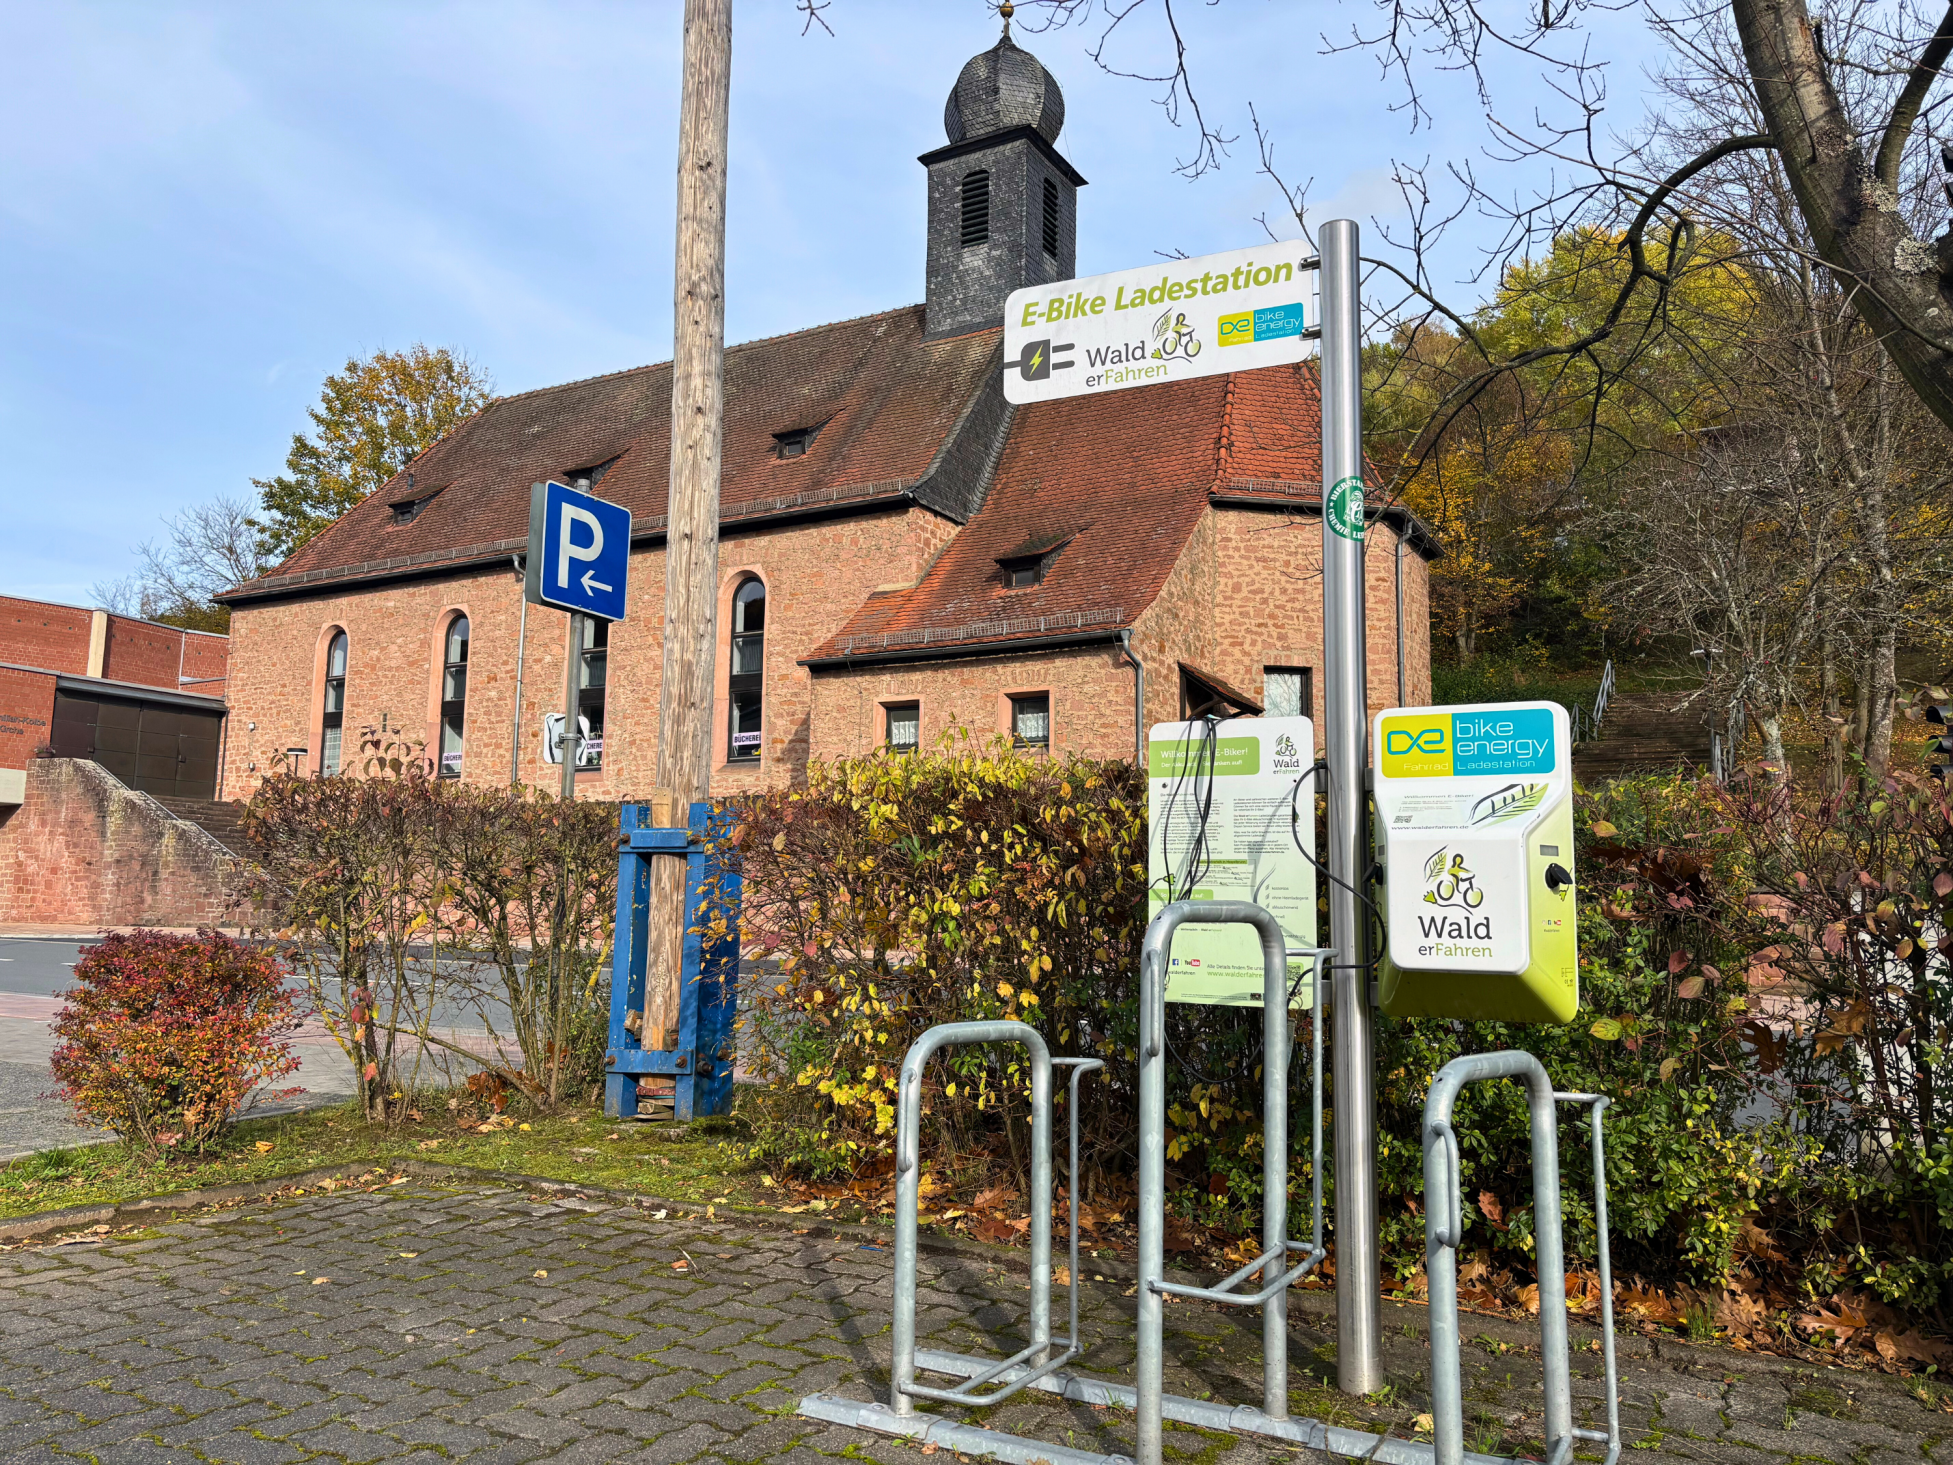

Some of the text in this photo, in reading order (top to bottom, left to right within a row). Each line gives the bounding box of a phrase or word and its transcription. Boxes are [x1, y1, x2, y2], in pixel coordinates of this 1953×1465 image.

[1020, 262, 1293, 327] E-Bike Ladestation
[1256, 311, 1284, 322] bike
[1256, 318, 1302, 332] energy
[1256, 328, 1294, 338] Ladestation
[1086, 340, 1146, 368] Wald
[1086, 364, 1168, 387] erFahren
[1330, 479, 1364, 500] BIERSTA
[1328, 508, 1350, 536] CHEMIE
[558, 502, 604, 589] P
[1456, 719, 1514, 738] bike
[1216, 748, 1248, 756] E-Biker!
[1456, 738, 1549, 758] energy
[1273, 758, 1300, 768] Wald
[1404, 760, 1536, 771] Fahrrad Ladestation
[1418, 916, 1492, 940] Wald
[1418, 943, 1492, 957] erFahren
